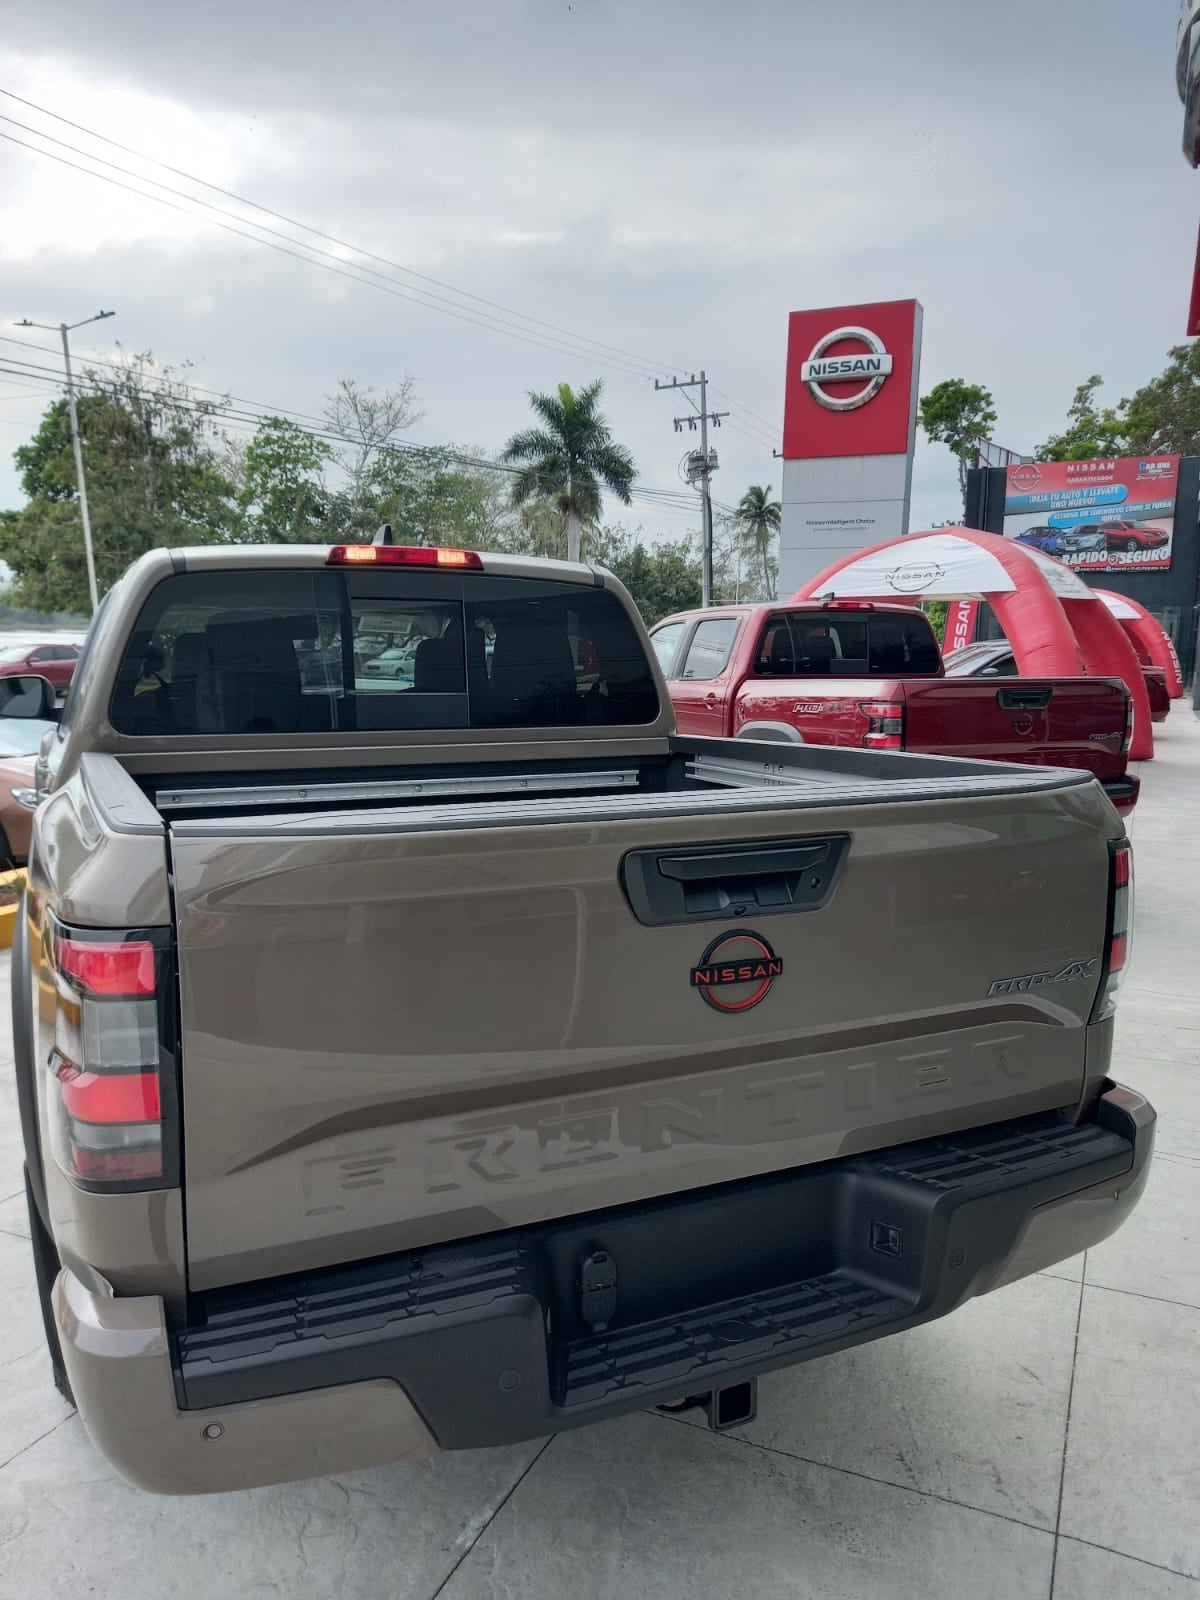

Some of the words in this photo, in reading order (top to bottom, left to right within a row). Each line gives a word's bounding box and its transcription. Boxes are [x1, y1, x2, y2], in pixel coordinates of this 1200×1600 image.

[809, 358, 881, 377] NISSAN
[1066, 461, 1115, 472] NISSAN
[1061, 491, 1081, 500] AUTO
[1089, 486, 1120, 497] LLEVATE
[1050, 500, 1066, 509] UNO
[1118, 548, 1170, 565] SEGURO
[884, 570, 946, 581] NISSAN
[1161, 631, 1183, 684] NISSAN
[694, 961, 781, 984] NISSAN
[303, 1034, 1028, 1217] FRONTIER
